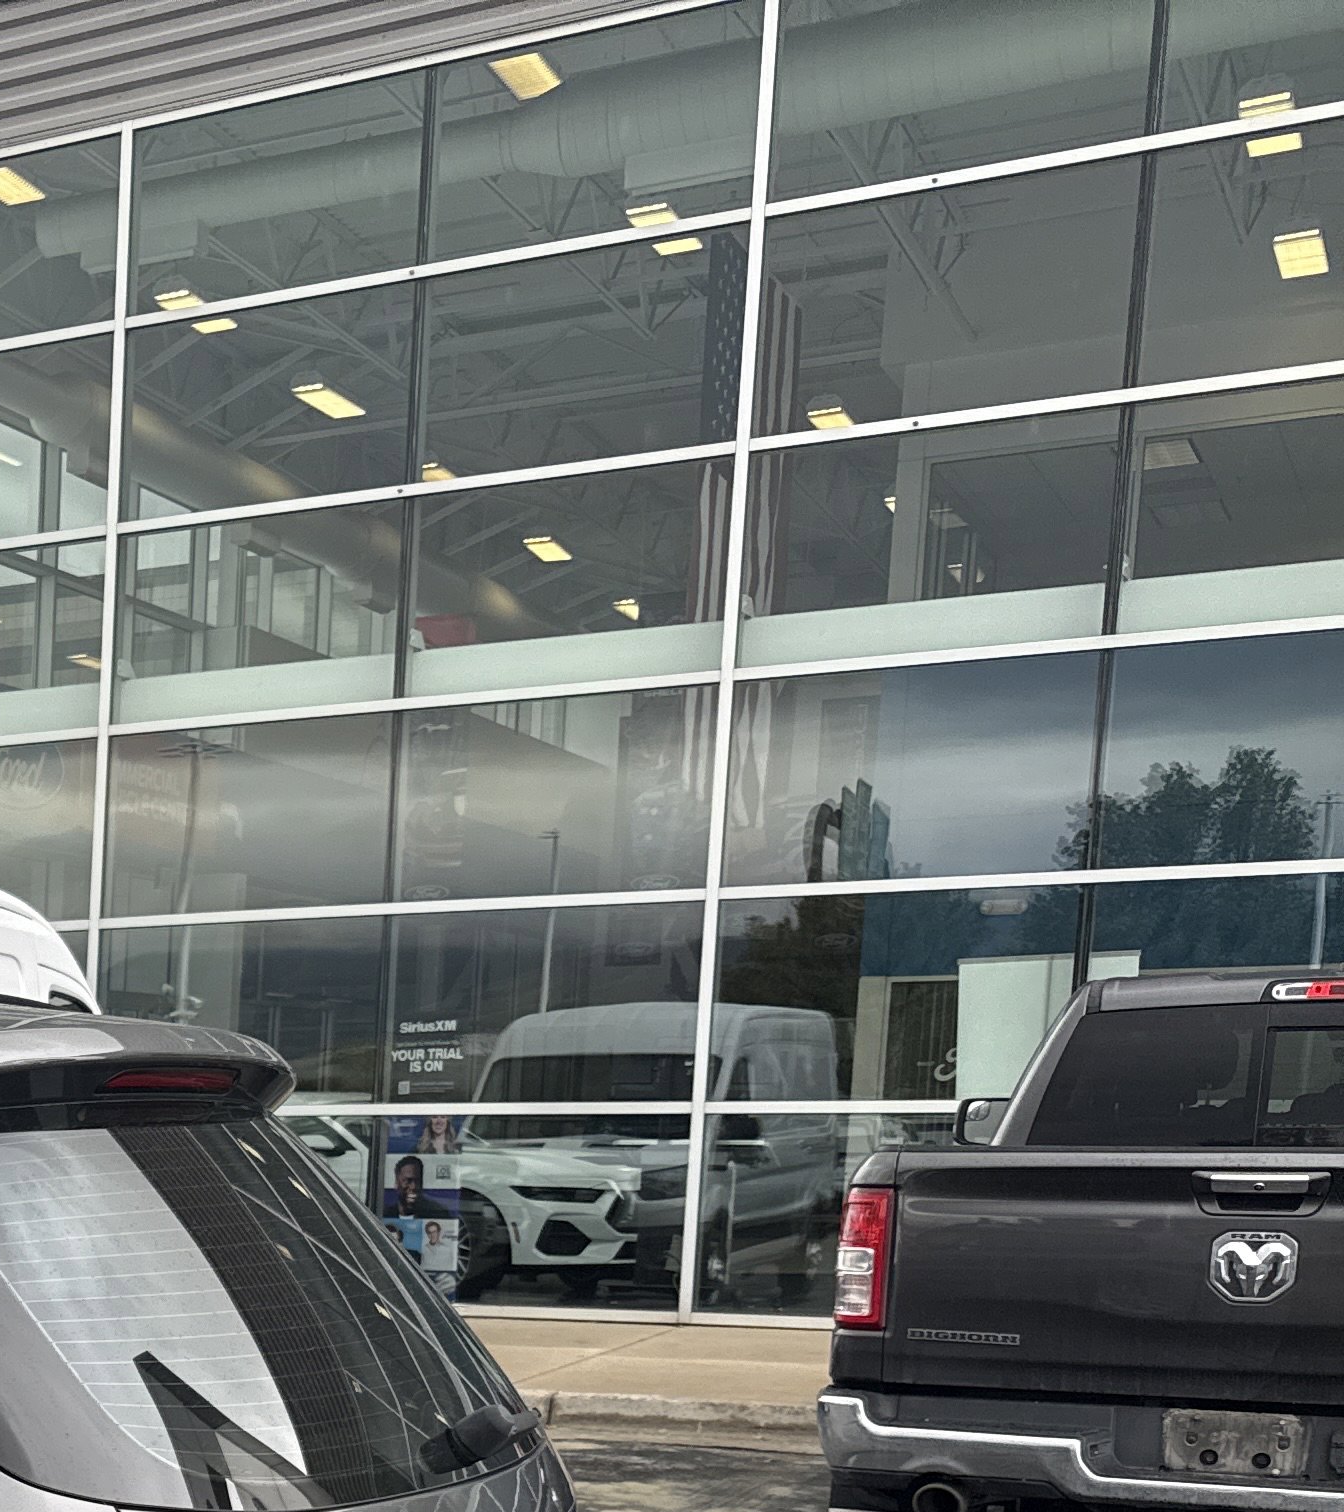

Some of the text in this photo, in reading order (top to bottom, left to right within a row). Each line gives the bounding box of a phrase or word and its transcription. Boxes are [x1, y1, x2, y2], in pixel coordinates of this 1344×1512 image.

[399, 1019, 457, 1034] SiriusXM
[392, 1047, 464, 1062] YOUR TRIAL
[409, 1060, 444, 1073] IS ON
